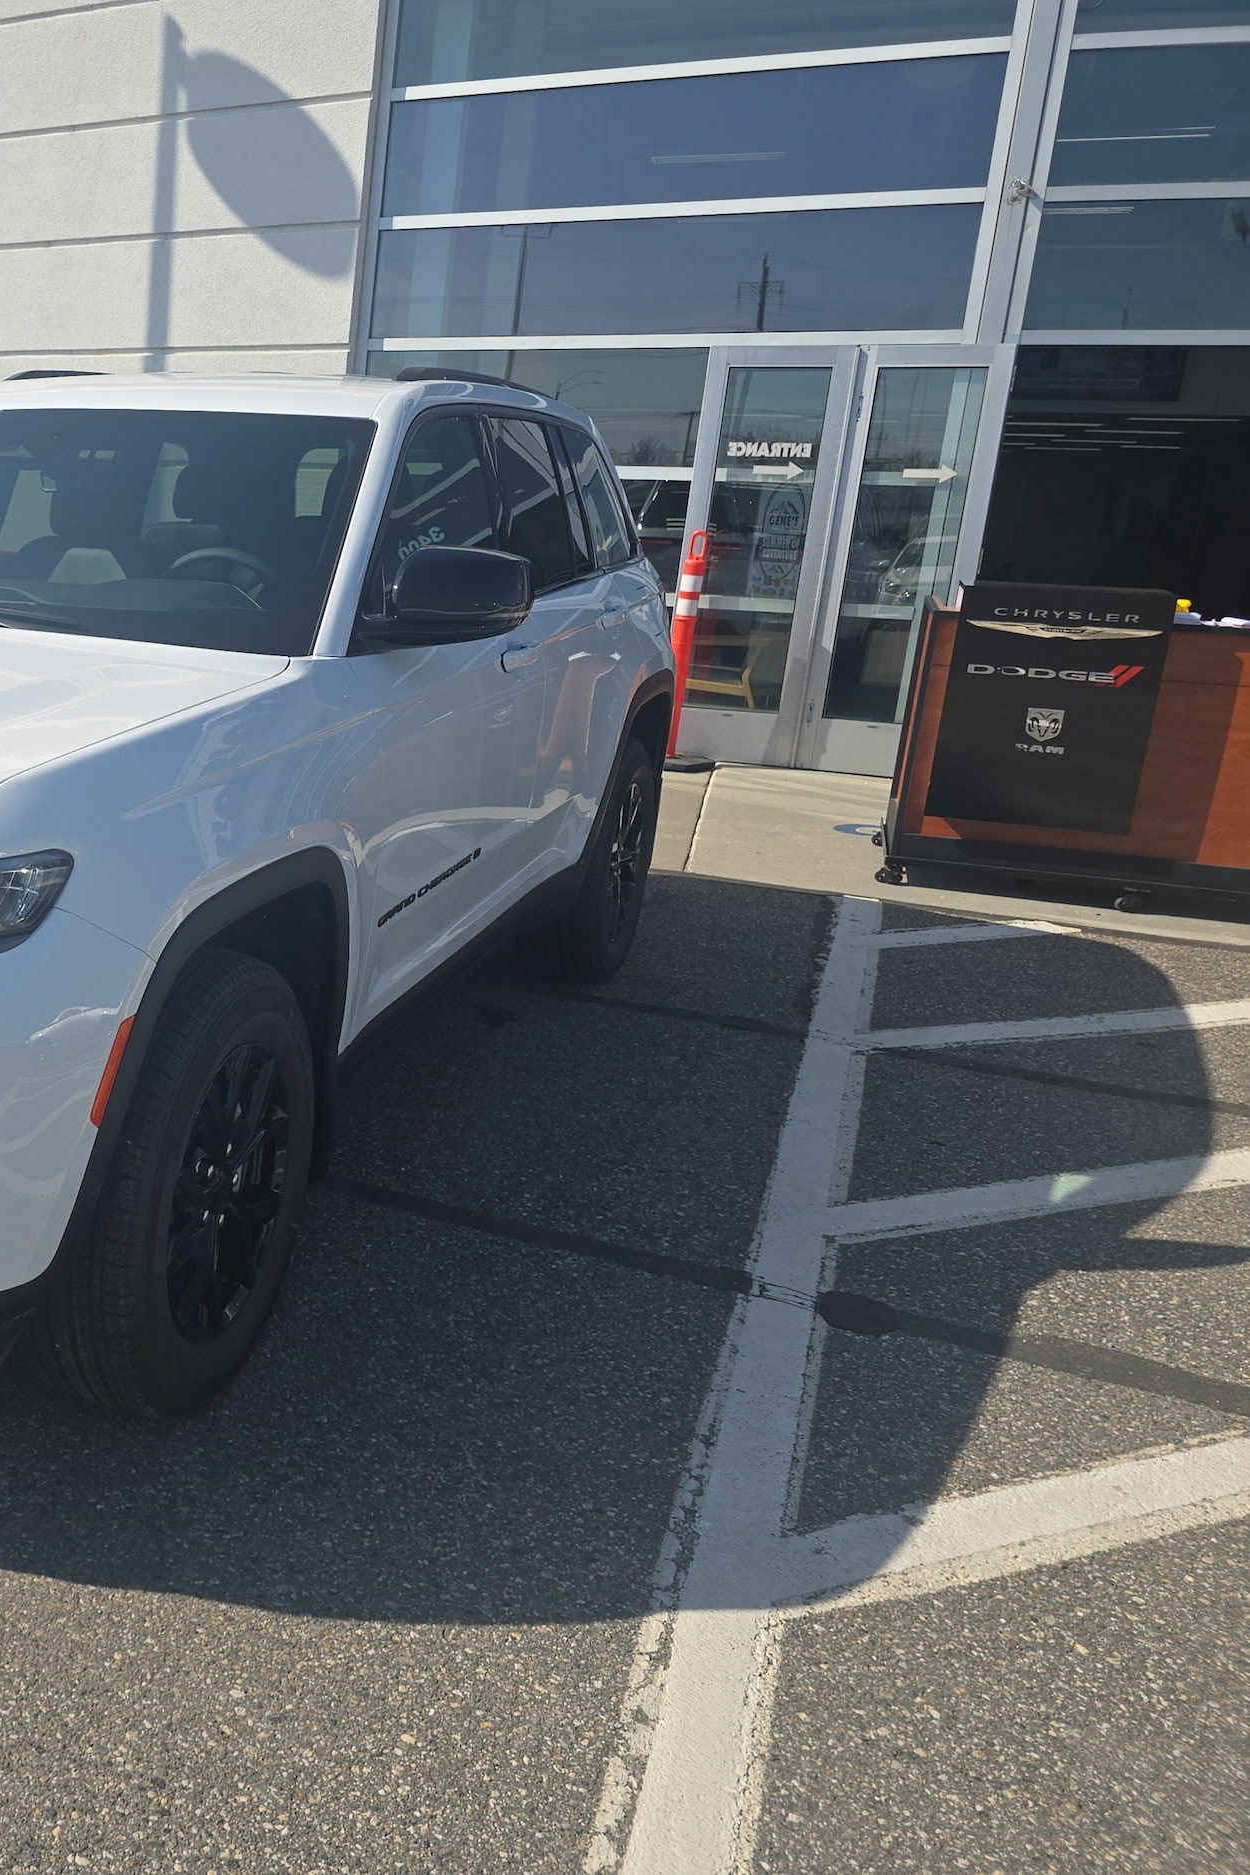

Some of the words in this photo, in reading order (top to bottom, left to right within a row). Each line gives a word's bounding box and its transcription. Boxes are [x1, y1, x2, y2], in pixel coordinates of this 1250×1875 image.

[769, 515, 800, 526] GENE'S
[761, 536, 791, 549] SUMMER
[791, 539, 801, 549] OF
[761, 548, 799, 561] ADVENTURE
[994, 607, 1140, 624] CHRYSLER
[967, 664, 1115, 684] DODGE
[1015, 743, 1065, 755] RAM
